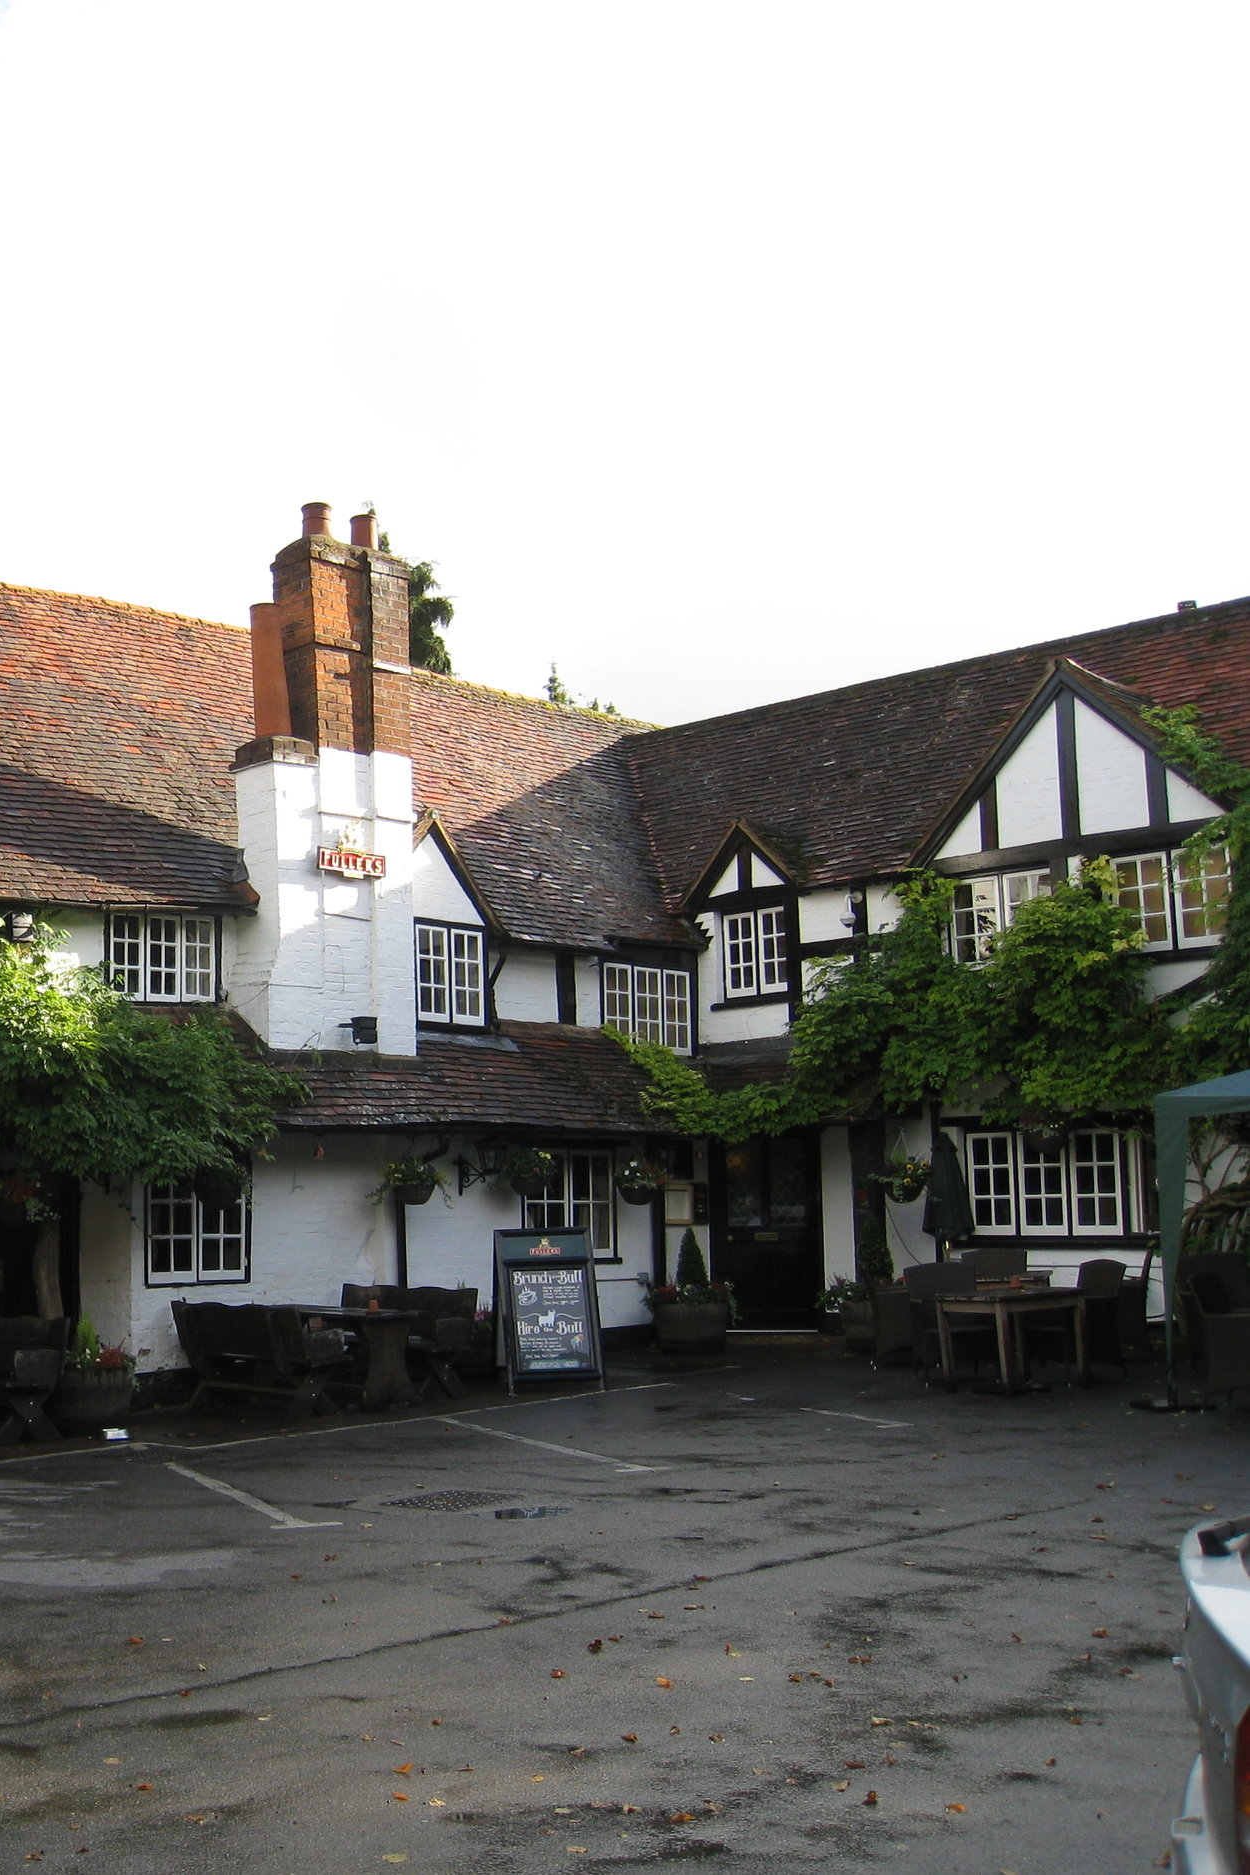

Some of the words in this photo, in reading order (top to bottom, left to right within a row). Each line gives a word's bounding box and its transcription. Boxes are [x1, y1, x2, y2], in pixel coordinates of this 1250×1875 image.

[513, 1271, 552, 1286] Brunch
[557, 1270, 582, 1284] Bull
[517, 1321, 540, 1335] Hire
[556, 1321, 582, 1335] Bull
